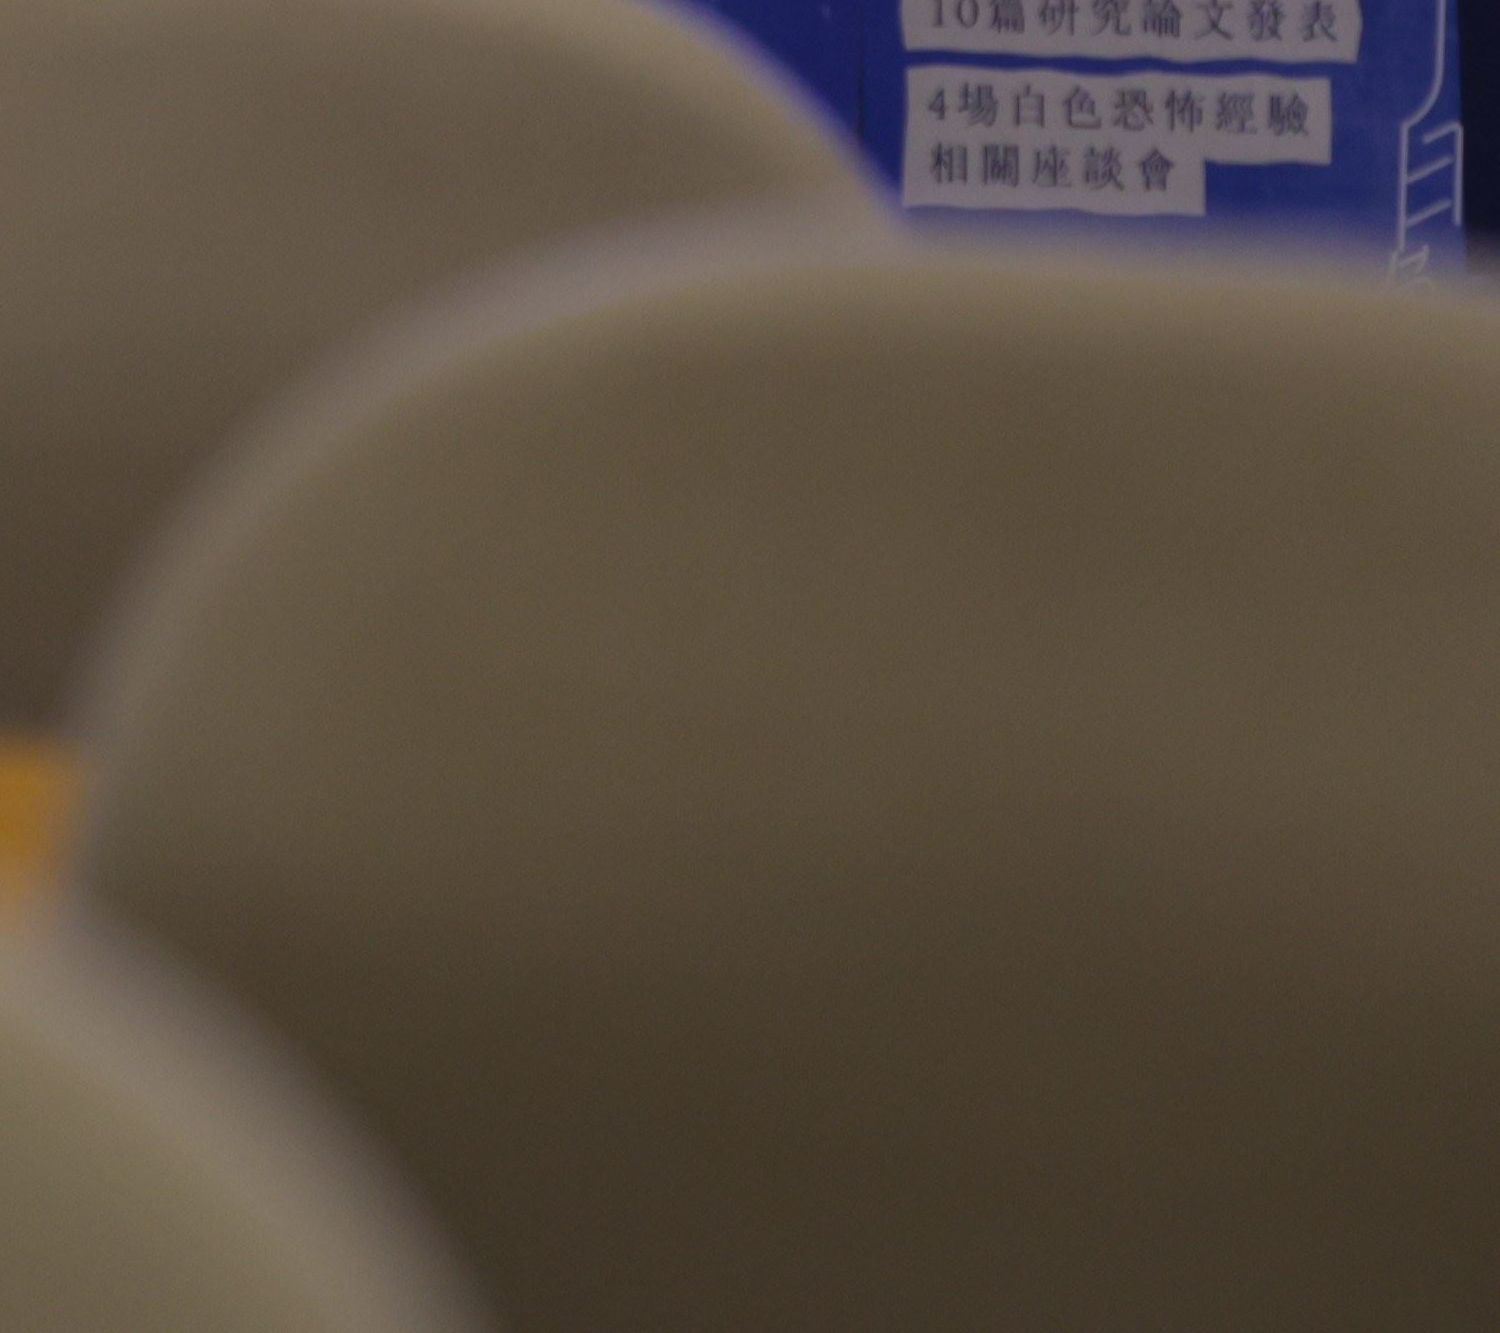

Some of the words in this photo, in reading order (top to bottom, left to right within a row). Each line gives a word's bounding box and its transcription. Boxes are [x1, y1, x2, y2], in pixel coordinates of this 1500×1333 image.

[926, 82, 1313, 138] 4場白色恐怖經驗
[929, 139, 1176, 193] 相關座談會
